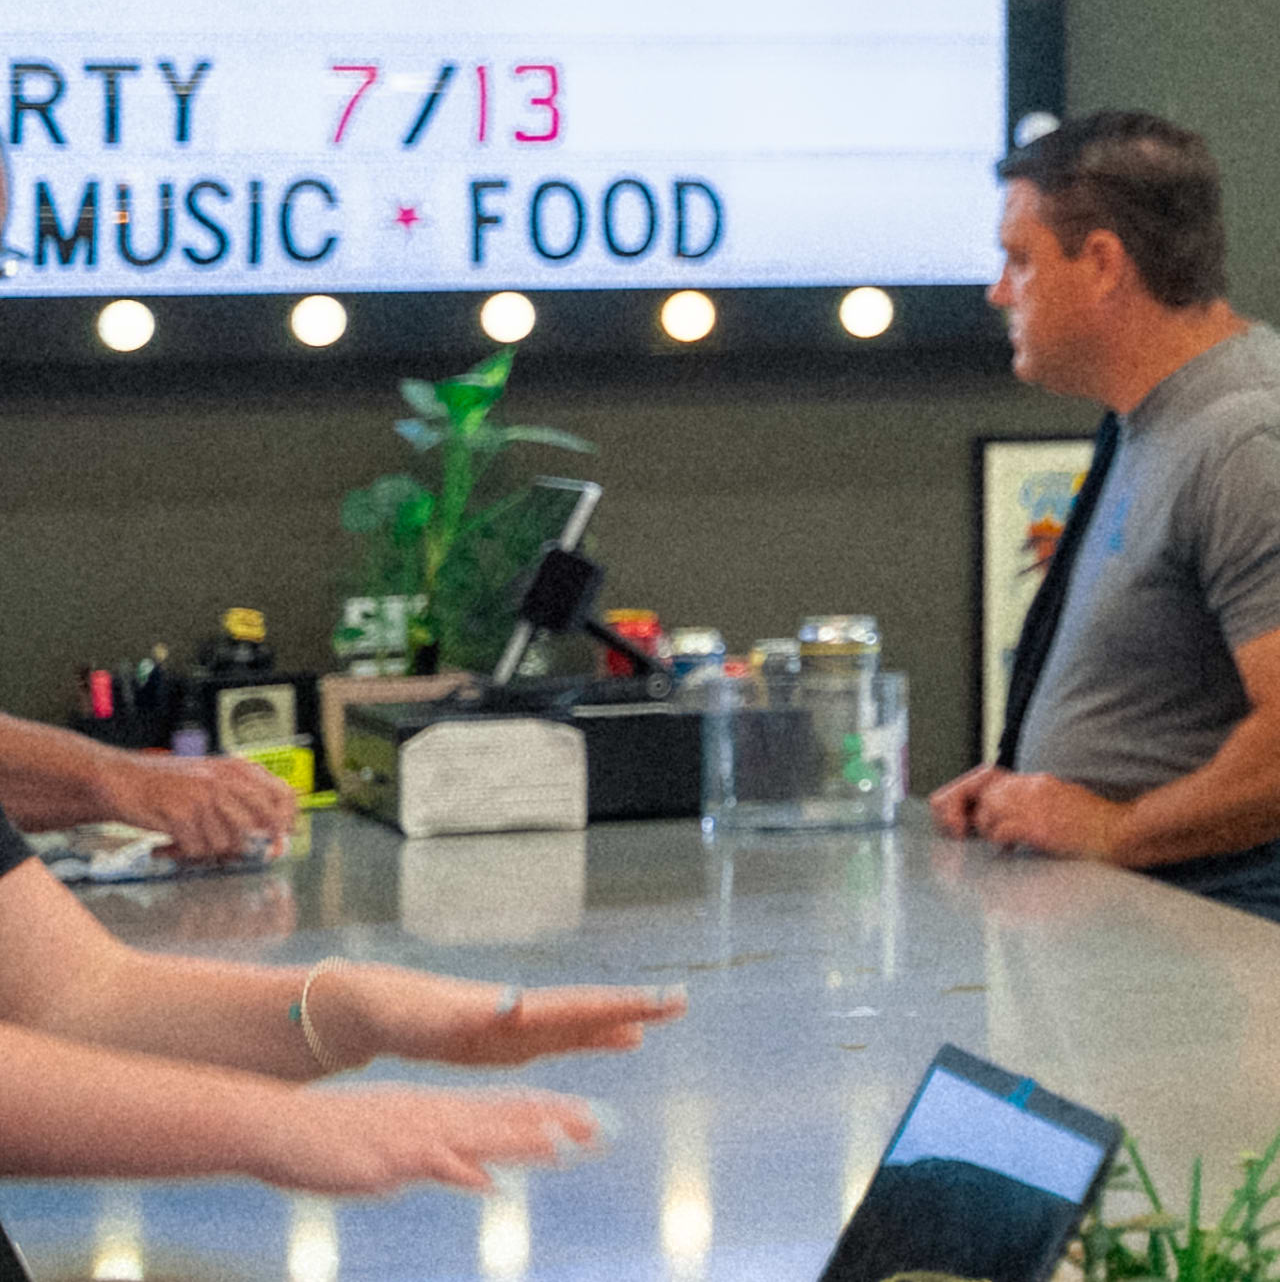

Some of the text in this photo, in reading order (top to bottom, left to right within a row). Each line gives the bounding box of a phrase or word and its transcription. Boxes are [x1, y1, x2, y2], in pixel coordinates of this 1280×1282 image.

[9, 61, 560, 147] RTY 7/13
[34, 179, 724, 270] MUSIC FOOD
